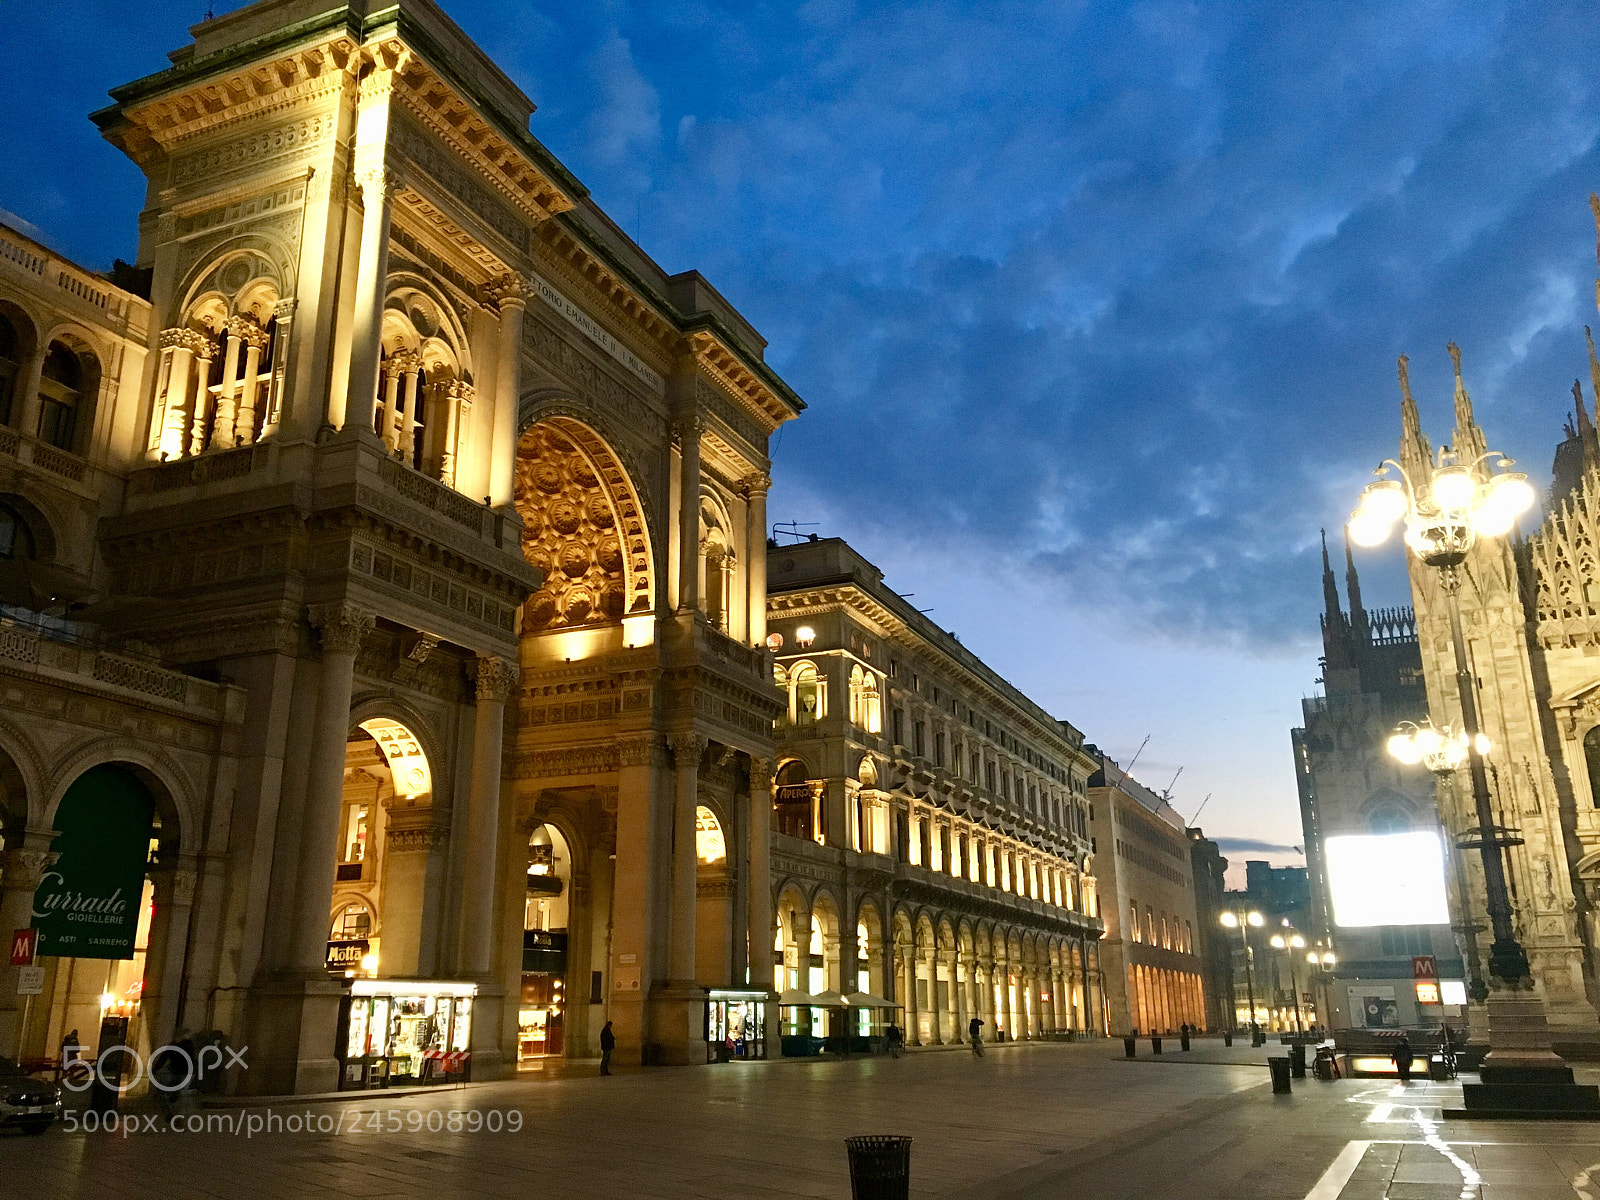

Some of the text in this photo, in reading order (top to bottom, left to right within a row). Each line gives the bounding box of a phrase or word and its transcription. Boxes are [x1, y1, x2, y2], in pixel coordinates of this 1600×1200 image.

[566, 304, 608, 346] EMANUELE
[629, 356, 659, 387] MILANESI
[32, 872, 127, 918] Currado
[67, 912, 125, 925] GIOIELLERIE
[12, 937, 30, 958] M
[59, 935, 77, 943] ASTI
[88, 937, 129, 946] SANREMO
[327, 945, 362, 962] Motta
[1415, 960, 1434, 974] M
